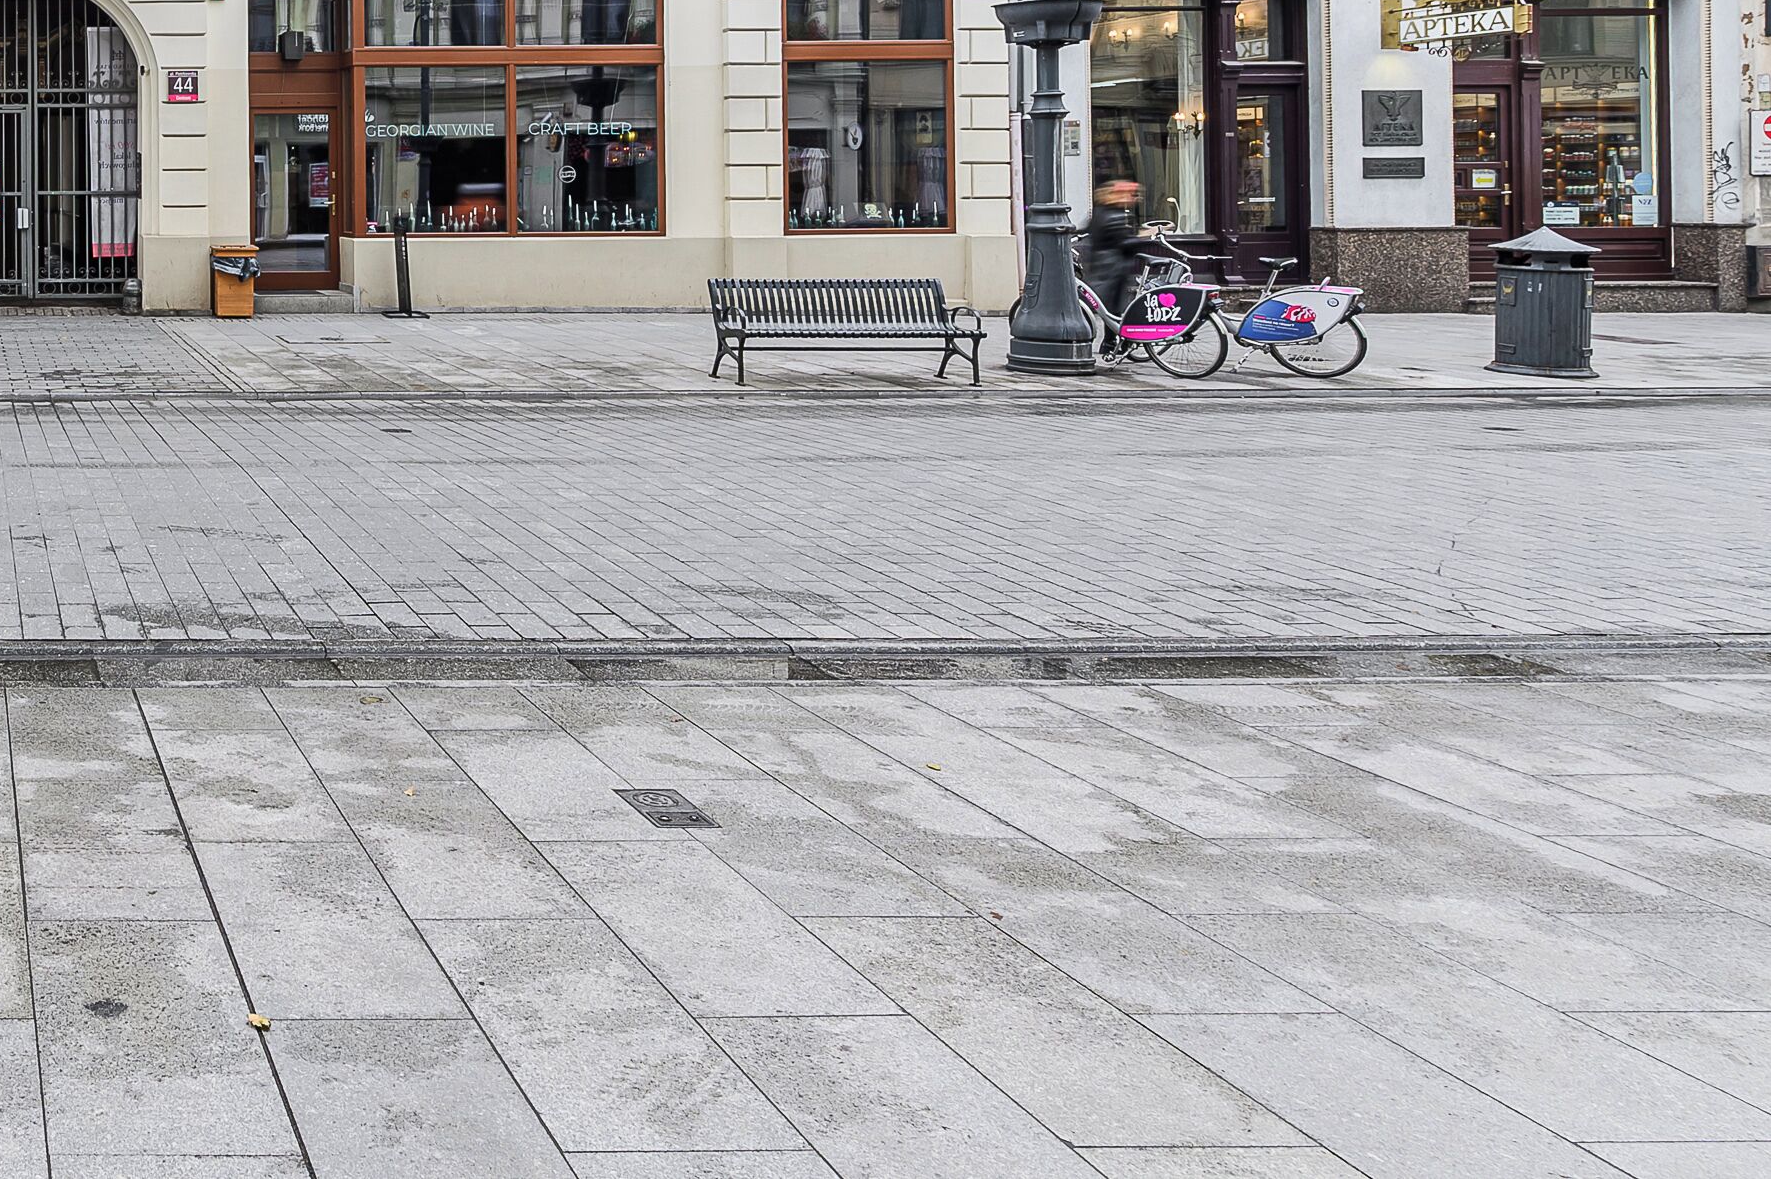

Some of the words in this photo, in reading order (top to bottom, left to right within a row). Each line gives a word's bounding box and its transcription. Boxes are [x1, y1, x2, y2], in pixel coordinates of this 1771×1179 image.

[1403, 10, 1510, 41] APTEKA
[173, 77, 194, 93] 44
[365, 124, 449, 138] GEORGIAN
[451, 123, 495, 137] WINE
[528, 122, 583, 136] CRAFT
[587, 121, 632, 135] BEER
